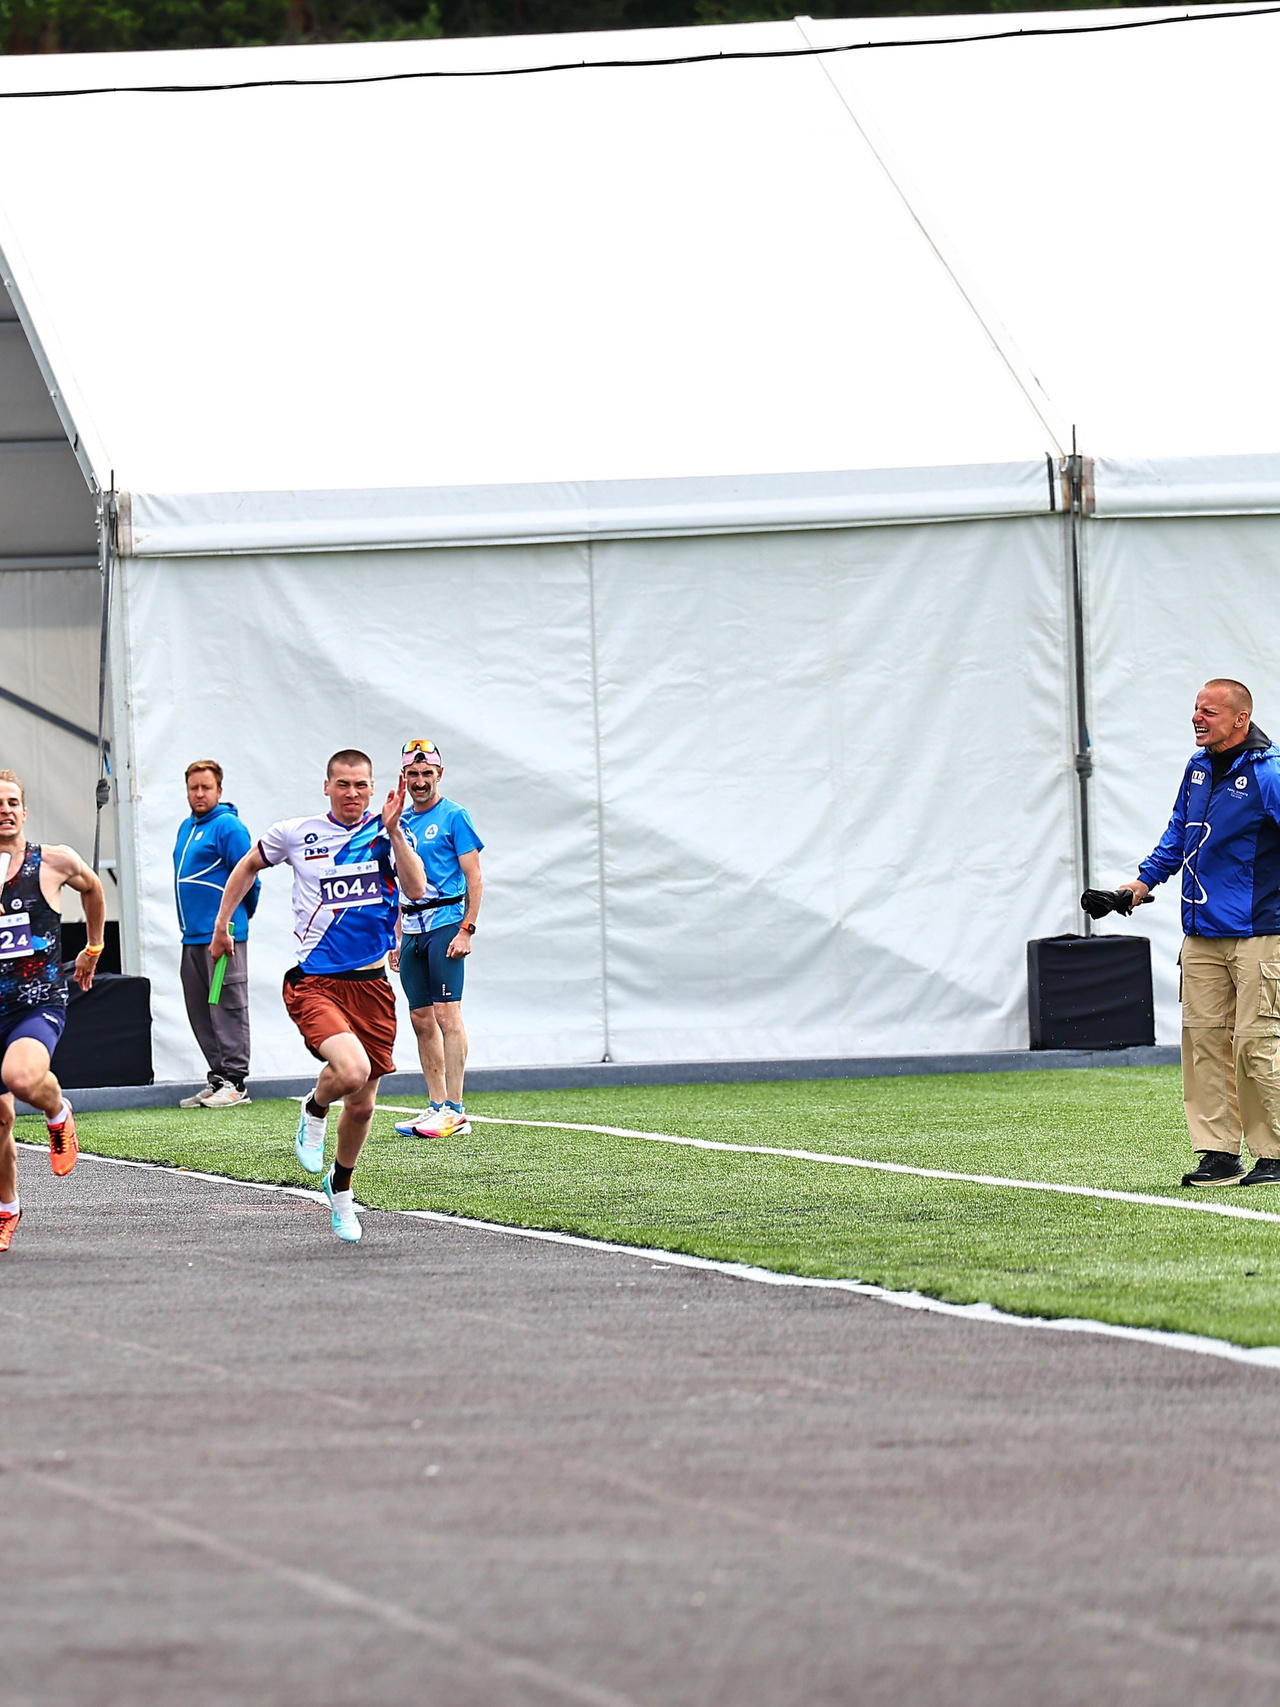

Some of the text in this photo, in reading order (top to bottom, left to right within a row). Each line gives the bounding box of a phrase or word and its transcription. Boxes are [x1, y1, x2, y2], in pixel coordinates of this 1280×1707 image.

[322, 878, 378, 900] 104 4
[17, 933, 29, 946] 4
